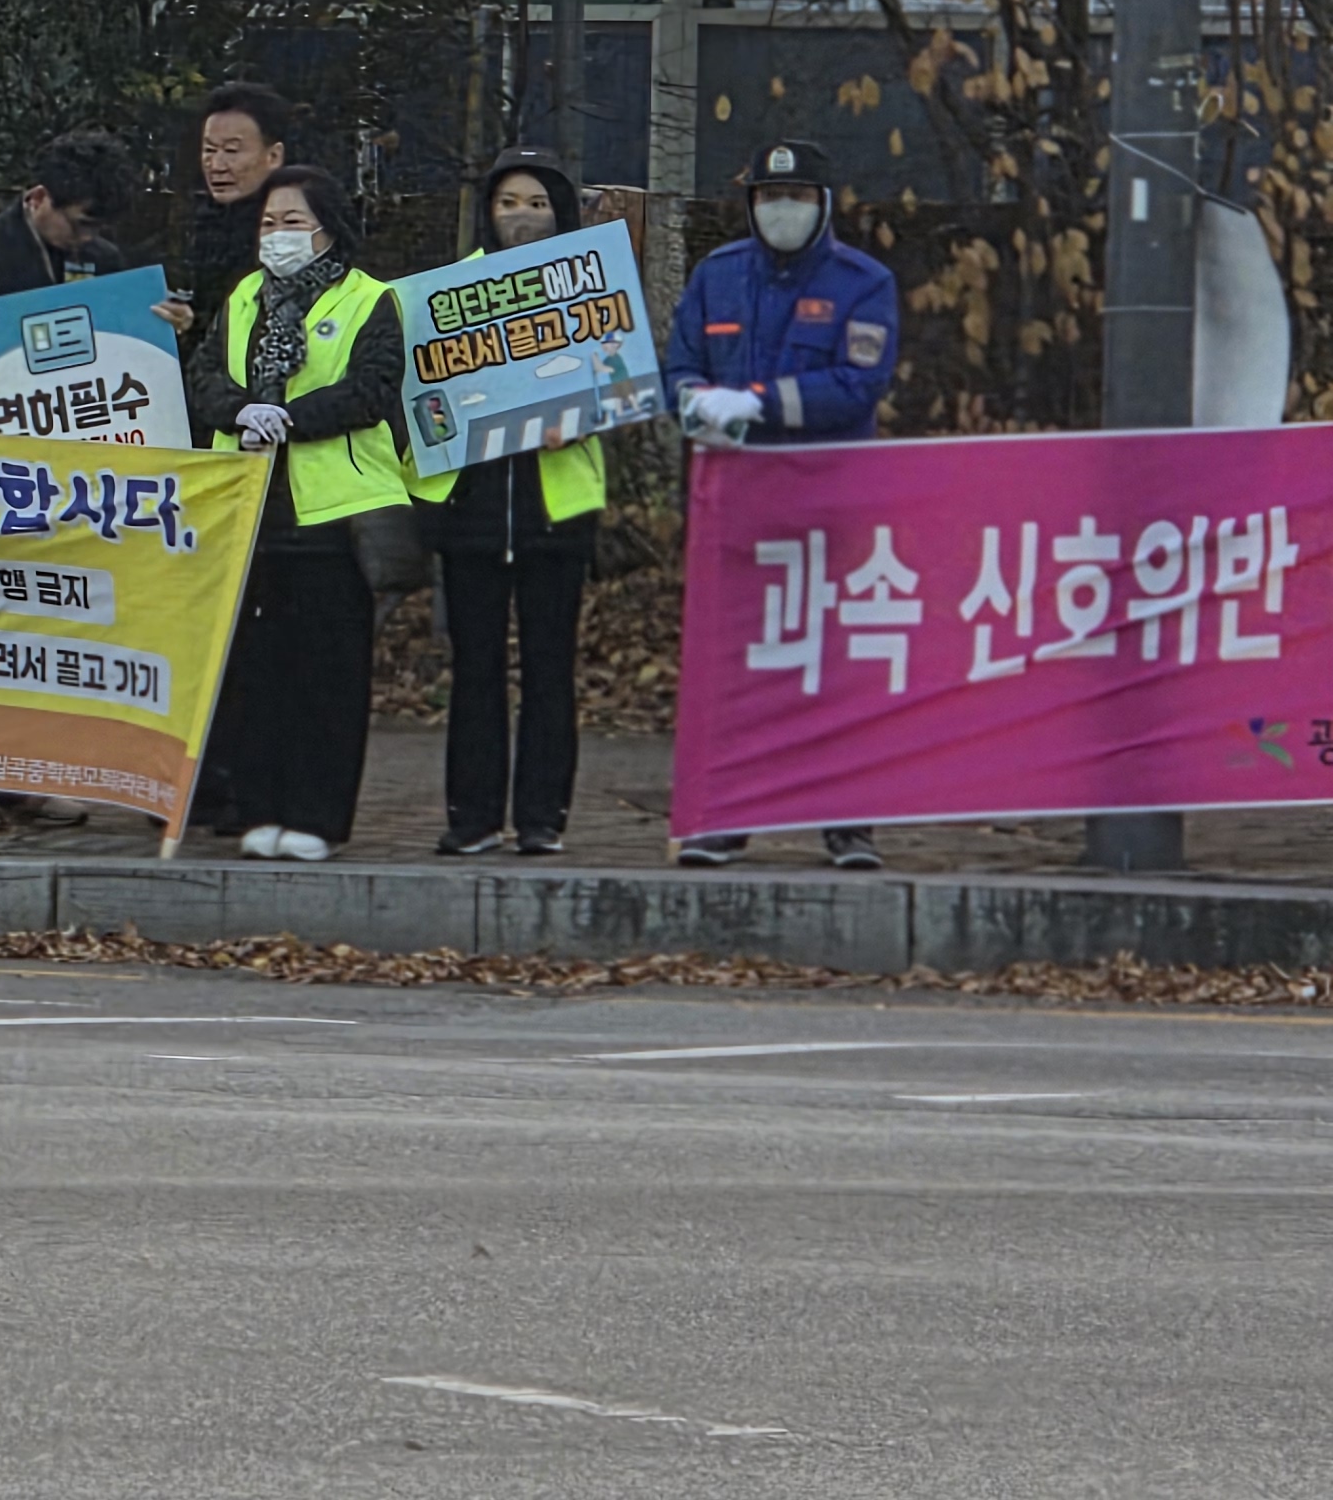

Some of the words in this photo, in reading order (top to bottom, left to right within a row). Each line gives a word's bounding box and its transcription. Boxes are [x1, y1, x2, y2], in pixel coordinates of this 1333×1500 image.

[414, 328, 506, 385] 내려서
[505, 306, 570, 361] 끌고
[567, 289, 636, 345] 가기
[36, 570, 91, 610] 금지
[746, 525, 924, 695] 과속
[959, 506, 1300, 682] 신호위반
[56, 649, 106, 697] 끌고
[114, 659, 159, 703] 가기
